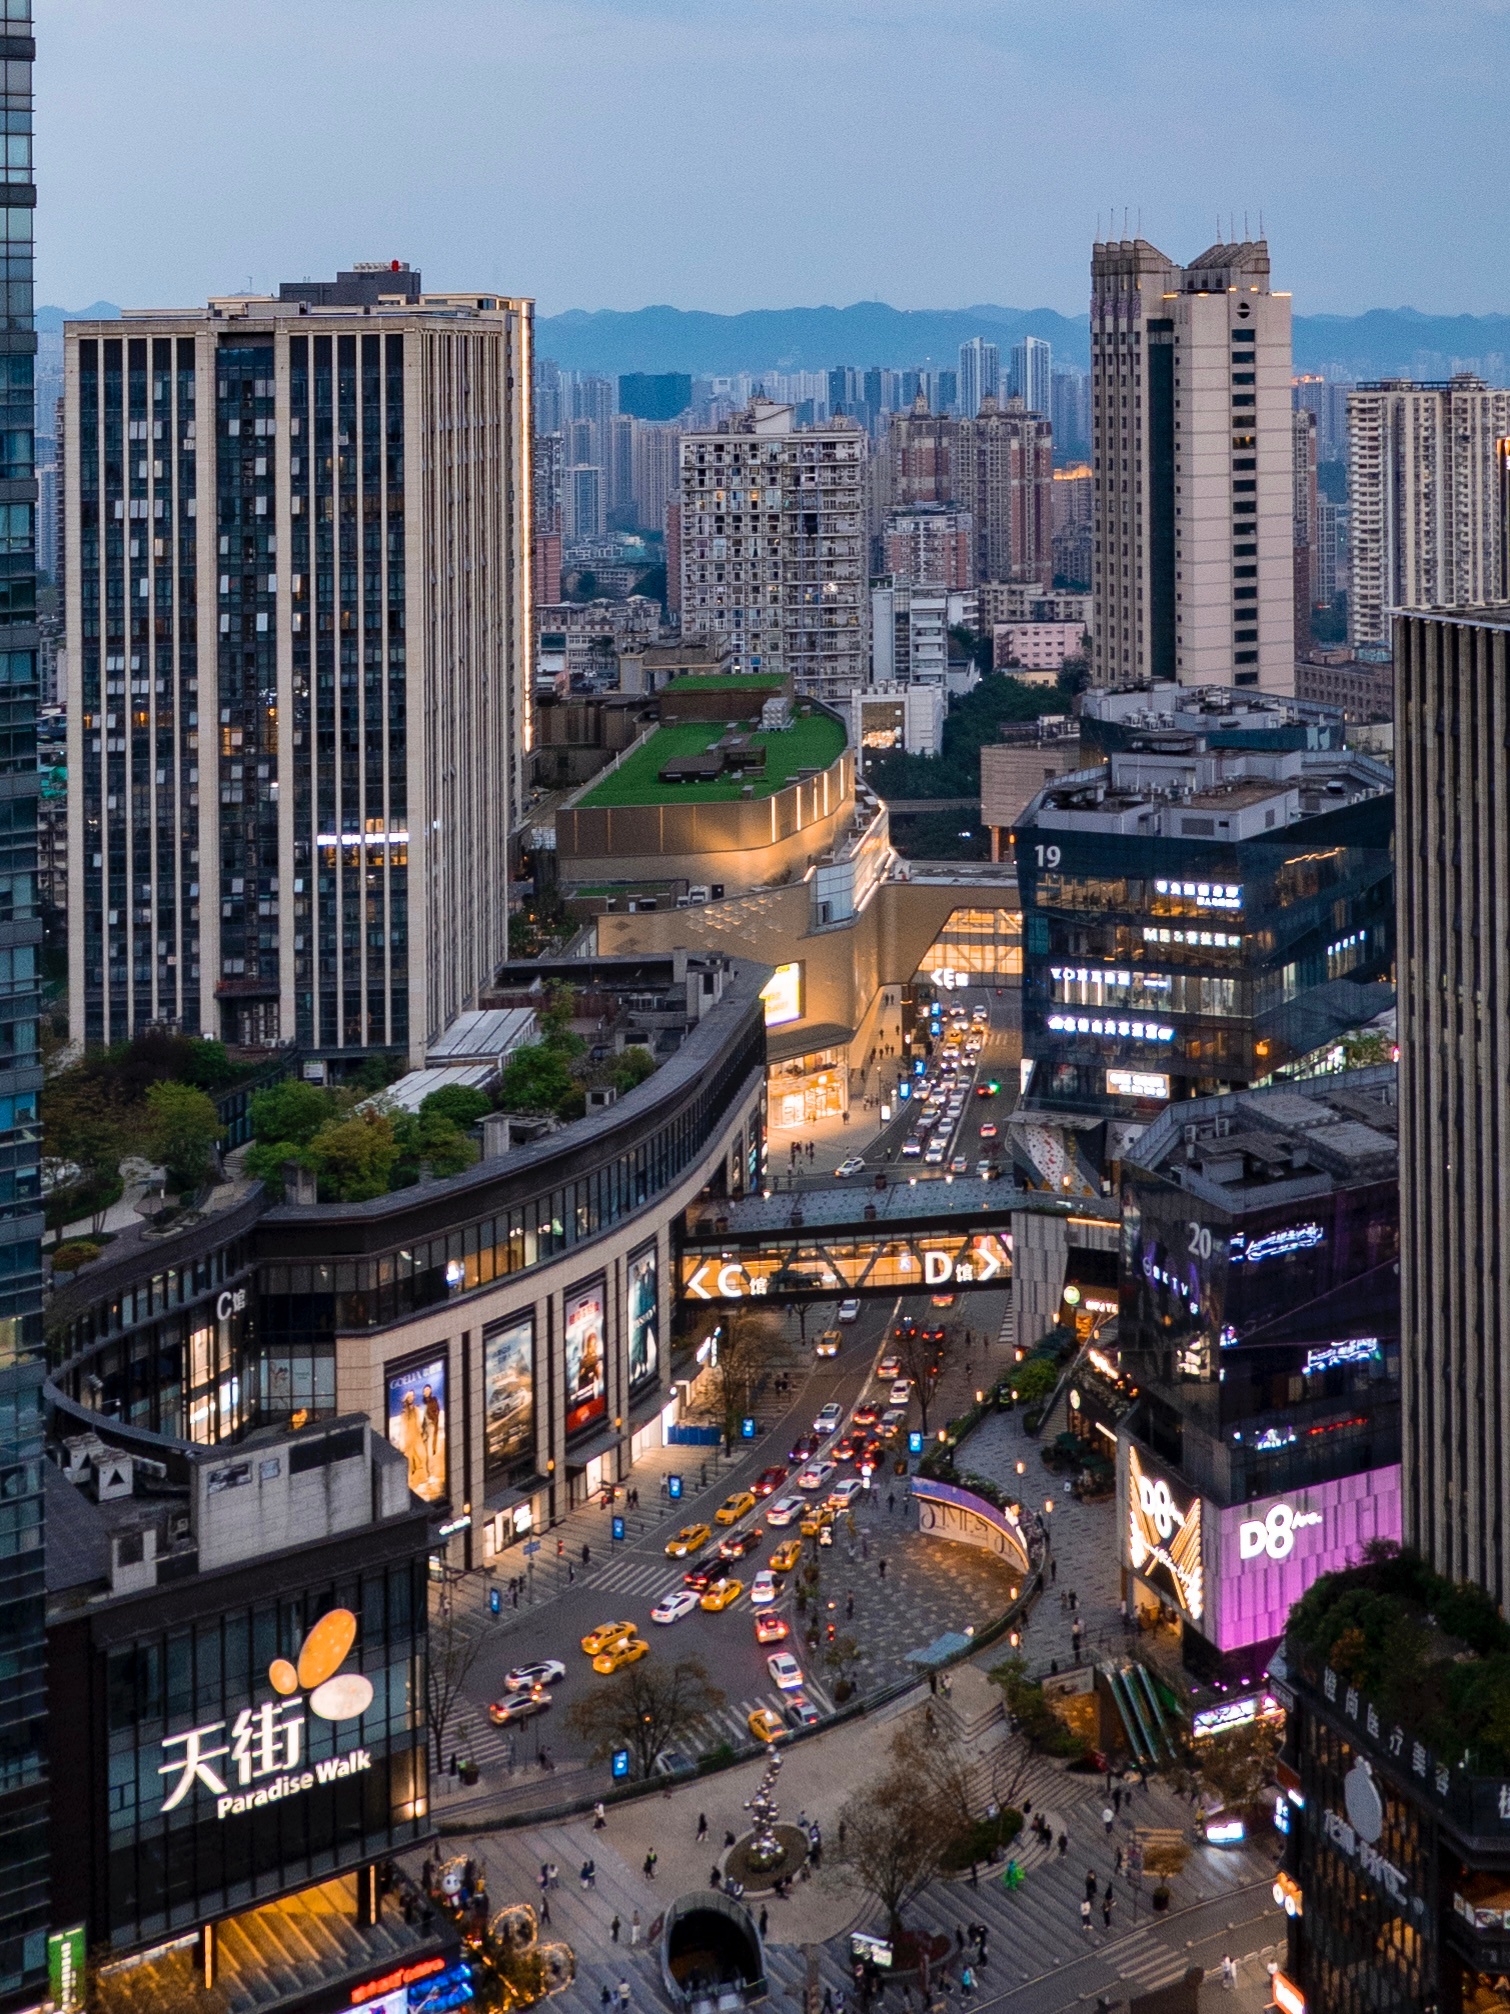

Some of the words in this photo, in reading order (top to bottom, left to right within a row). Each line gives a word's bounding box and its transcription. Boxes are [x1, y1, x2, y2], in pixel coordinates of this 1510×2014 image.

[1034, 844, 1061, 868] 19
[1188, 1222, 1211, 1259] 20
[717, 1264, 767, 1298] C馆
[924, 1251, 973, 1285] D馆
[216, 1288, 245, 1320] C馆
[1139, 1475, 1171, 1538] D8
[1239, 1503, 1294, 1559] D8
[158, 1697, 305, 1813] 天街
[217, 1772, 314, 1820] Paradise
[315, 1749, 371, 1785] Walk
